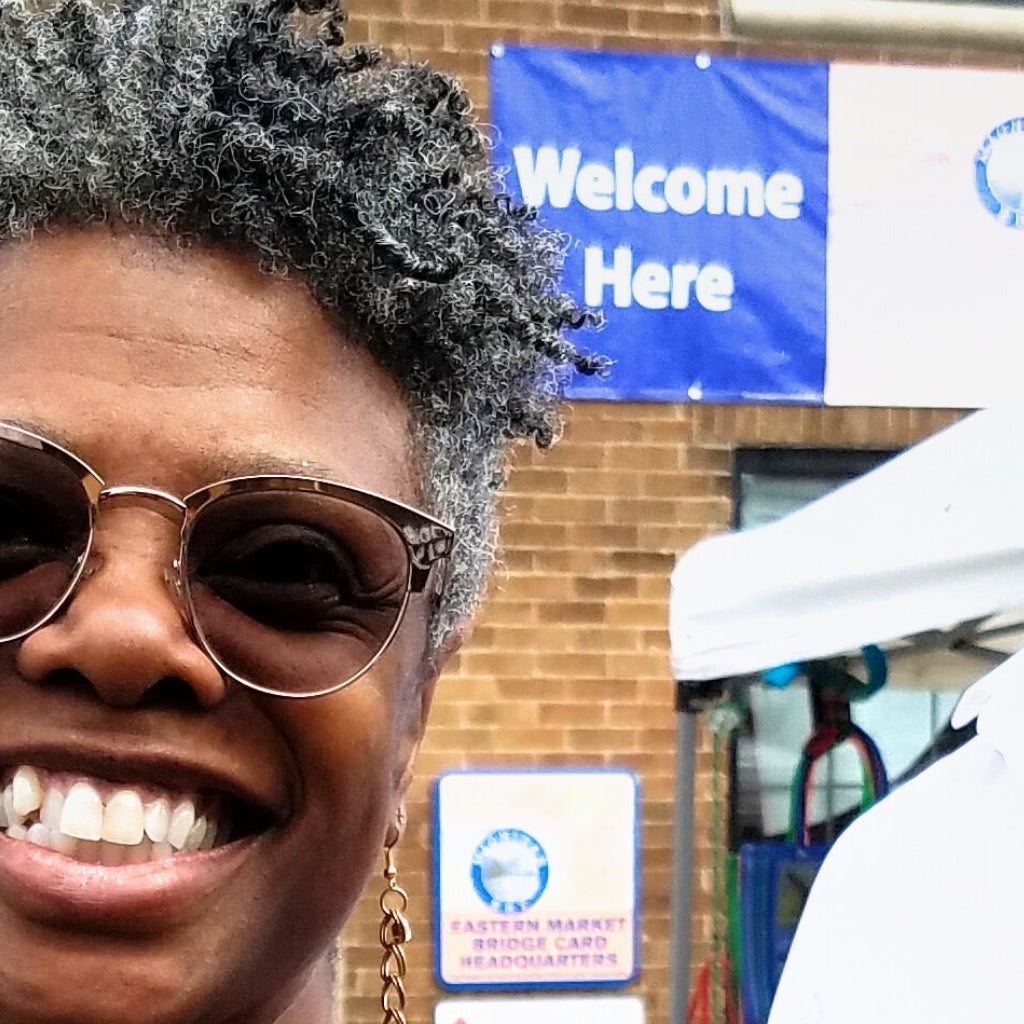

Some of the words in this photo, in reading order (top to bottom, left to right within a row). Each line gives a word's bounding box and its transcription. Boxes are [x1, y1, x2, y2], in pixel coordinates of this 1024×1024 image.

[513, 146, 804, 219] Welcome
[584, 246, 734, 311] Here
[451, 920, 540, 934] EASTERN
[548, 918, 627, 932] MARKET
[474, 937, 548, 951] BRIDGE
[554, 936, 608, 950] CARD
[460, 954, 619, 969] HEADQUARTERS
